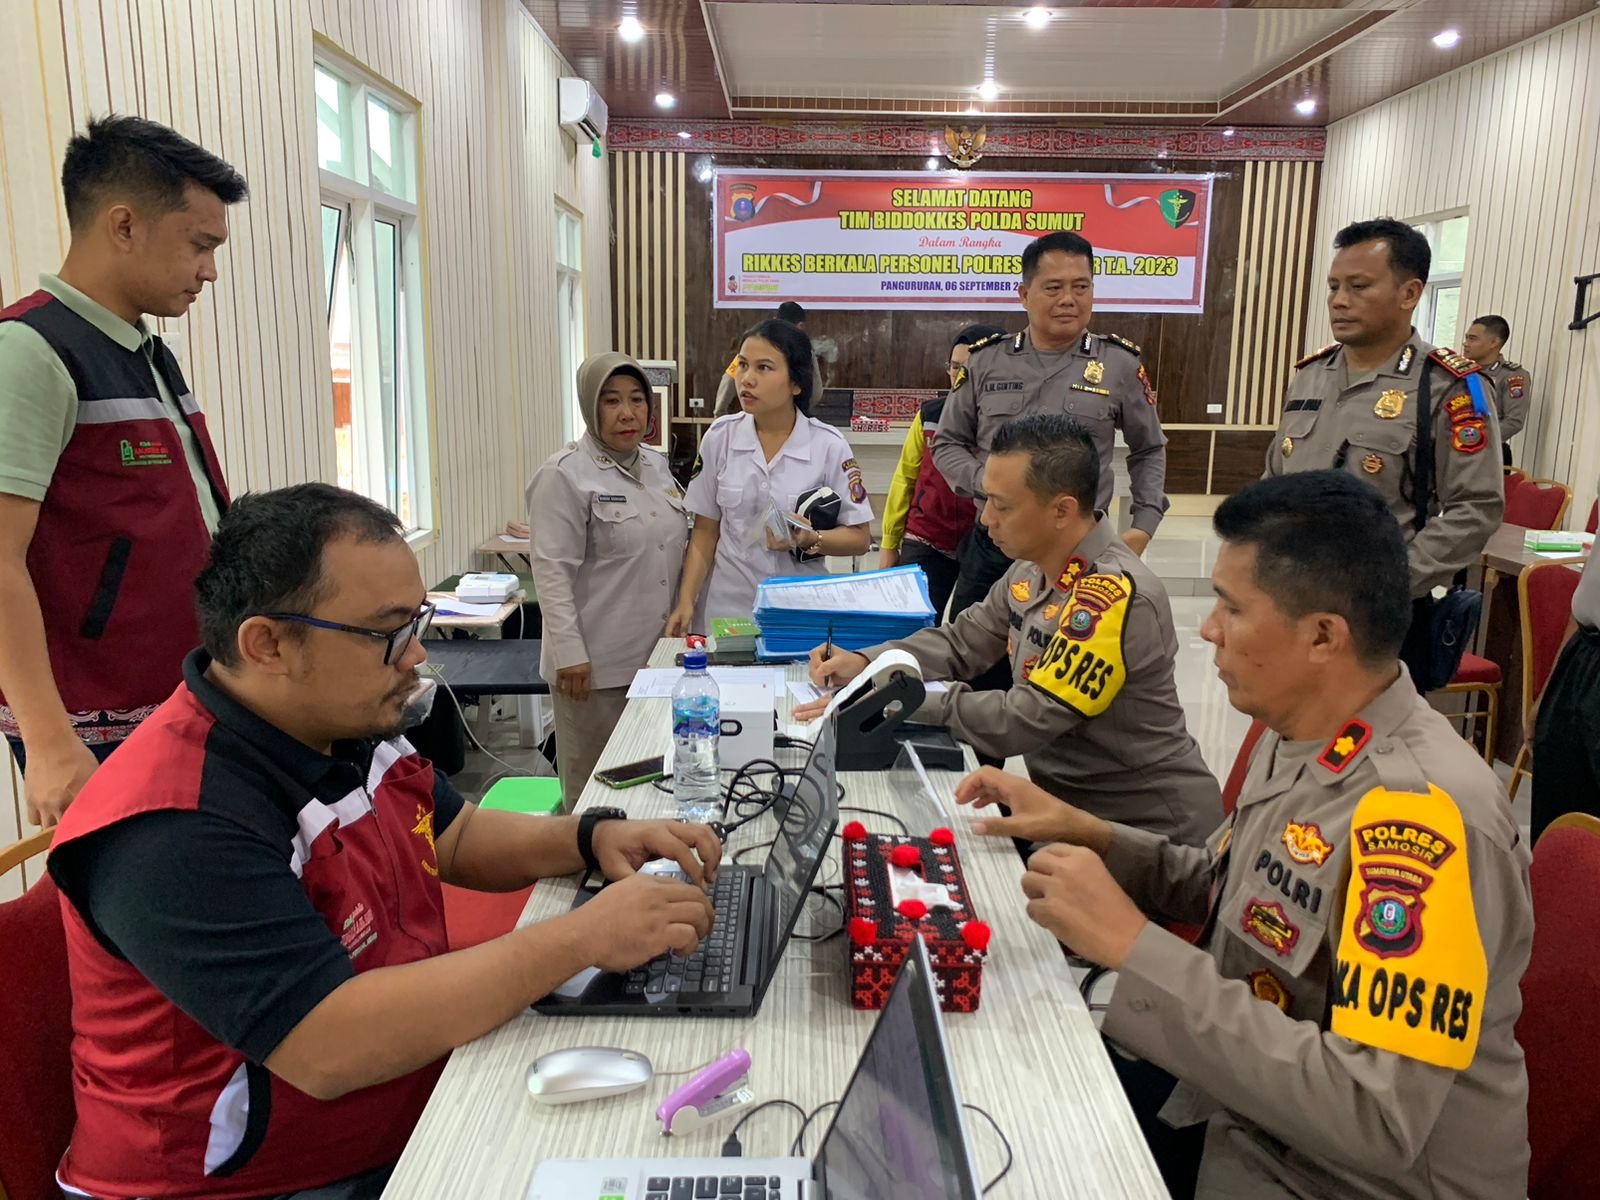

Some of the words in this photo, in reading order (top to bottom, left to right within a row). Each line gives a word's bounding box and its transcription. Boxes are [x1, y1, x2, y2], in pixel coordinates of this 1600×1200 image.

[891, 188, 967, 208] SELAMAT
[968, 189, 1032, 208] DATANG
[839, 210, 872, 229] TIM
[872, 211, 967, 230] BIDDOKKES
[970, 212, 1023, 230] POLDA
[1025, 212, 1085, 231] SUMUT
[918, 236, 956, 248] Dalam
[958, 236, 1002, 249] Rangka
[742, 253, 802, 272] RIKKES
[804, 254, 877, 273] BERKALA
[879, 255, 959, 274] PERSONEL
[962, 255, 1023, 274] POLRES
[1104, 257, 1131, 275] T.A.
[1133, 256, 1178, 275] 2023
[881, 281, 943, 292] PANGURURAN,
[945, 281, 957, 291] 06
[959, 281, 1011, 291] SEPTEMBER
[1081, 577, 1122, 597] POLRES
[1068, 651, 1114, 700] RES
[1361, 825, 1447, 854] POLRES
[1367, 840, 1435, 861] SAMOSIR
[1254, 849, 1322, 914] POLRI
[1368, 967, 1426, 1028] OPS
[1430, 983, 1473, 1042] RES
